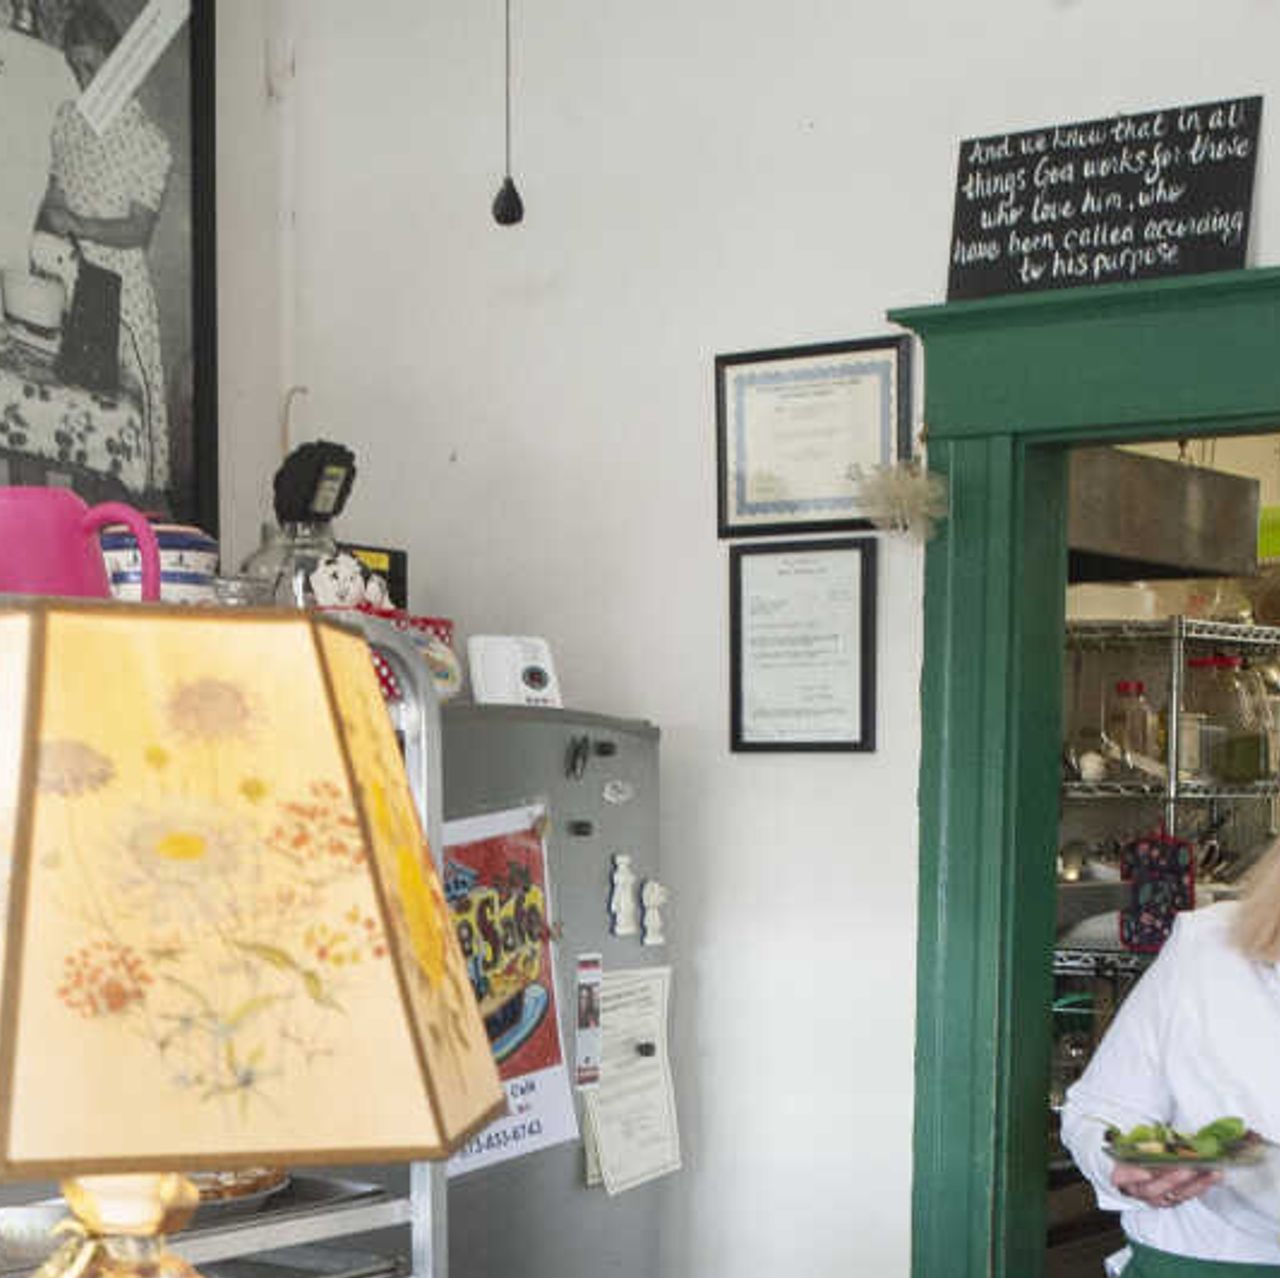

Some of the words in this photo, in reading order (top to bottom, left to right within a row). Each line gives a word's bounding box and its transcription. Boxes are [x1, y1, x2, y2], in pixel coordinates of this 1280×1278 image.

[1021, 137, 1048, 155] we
[1052, 129, 1106, 151] know
[1111, 115, 1165, 143] that
[1177, 108, 1202, 132] in
[1209, 104, 1246, 128] all
[961, 168, 1027, 209] things
[1083, 150, 1147, 178] works
[1145, 142, 1180, 183] for
[1187, 133, 1250, 165] those
[980, 202, 1022, 230] who
[1031, 193, 1076, 224] love
[1138, 178, 1187, 206] who
[953, 238, 1001, 265] have
[1009, 229, 1054, 253] been
[1063, 218, 1133, 250] called
[1144, 210, 1244, 244] according
[1019, 259, 1045, 284] to
[1052, 253, 1089, 278] his
[1093, 243, 1180, 280] purpose
